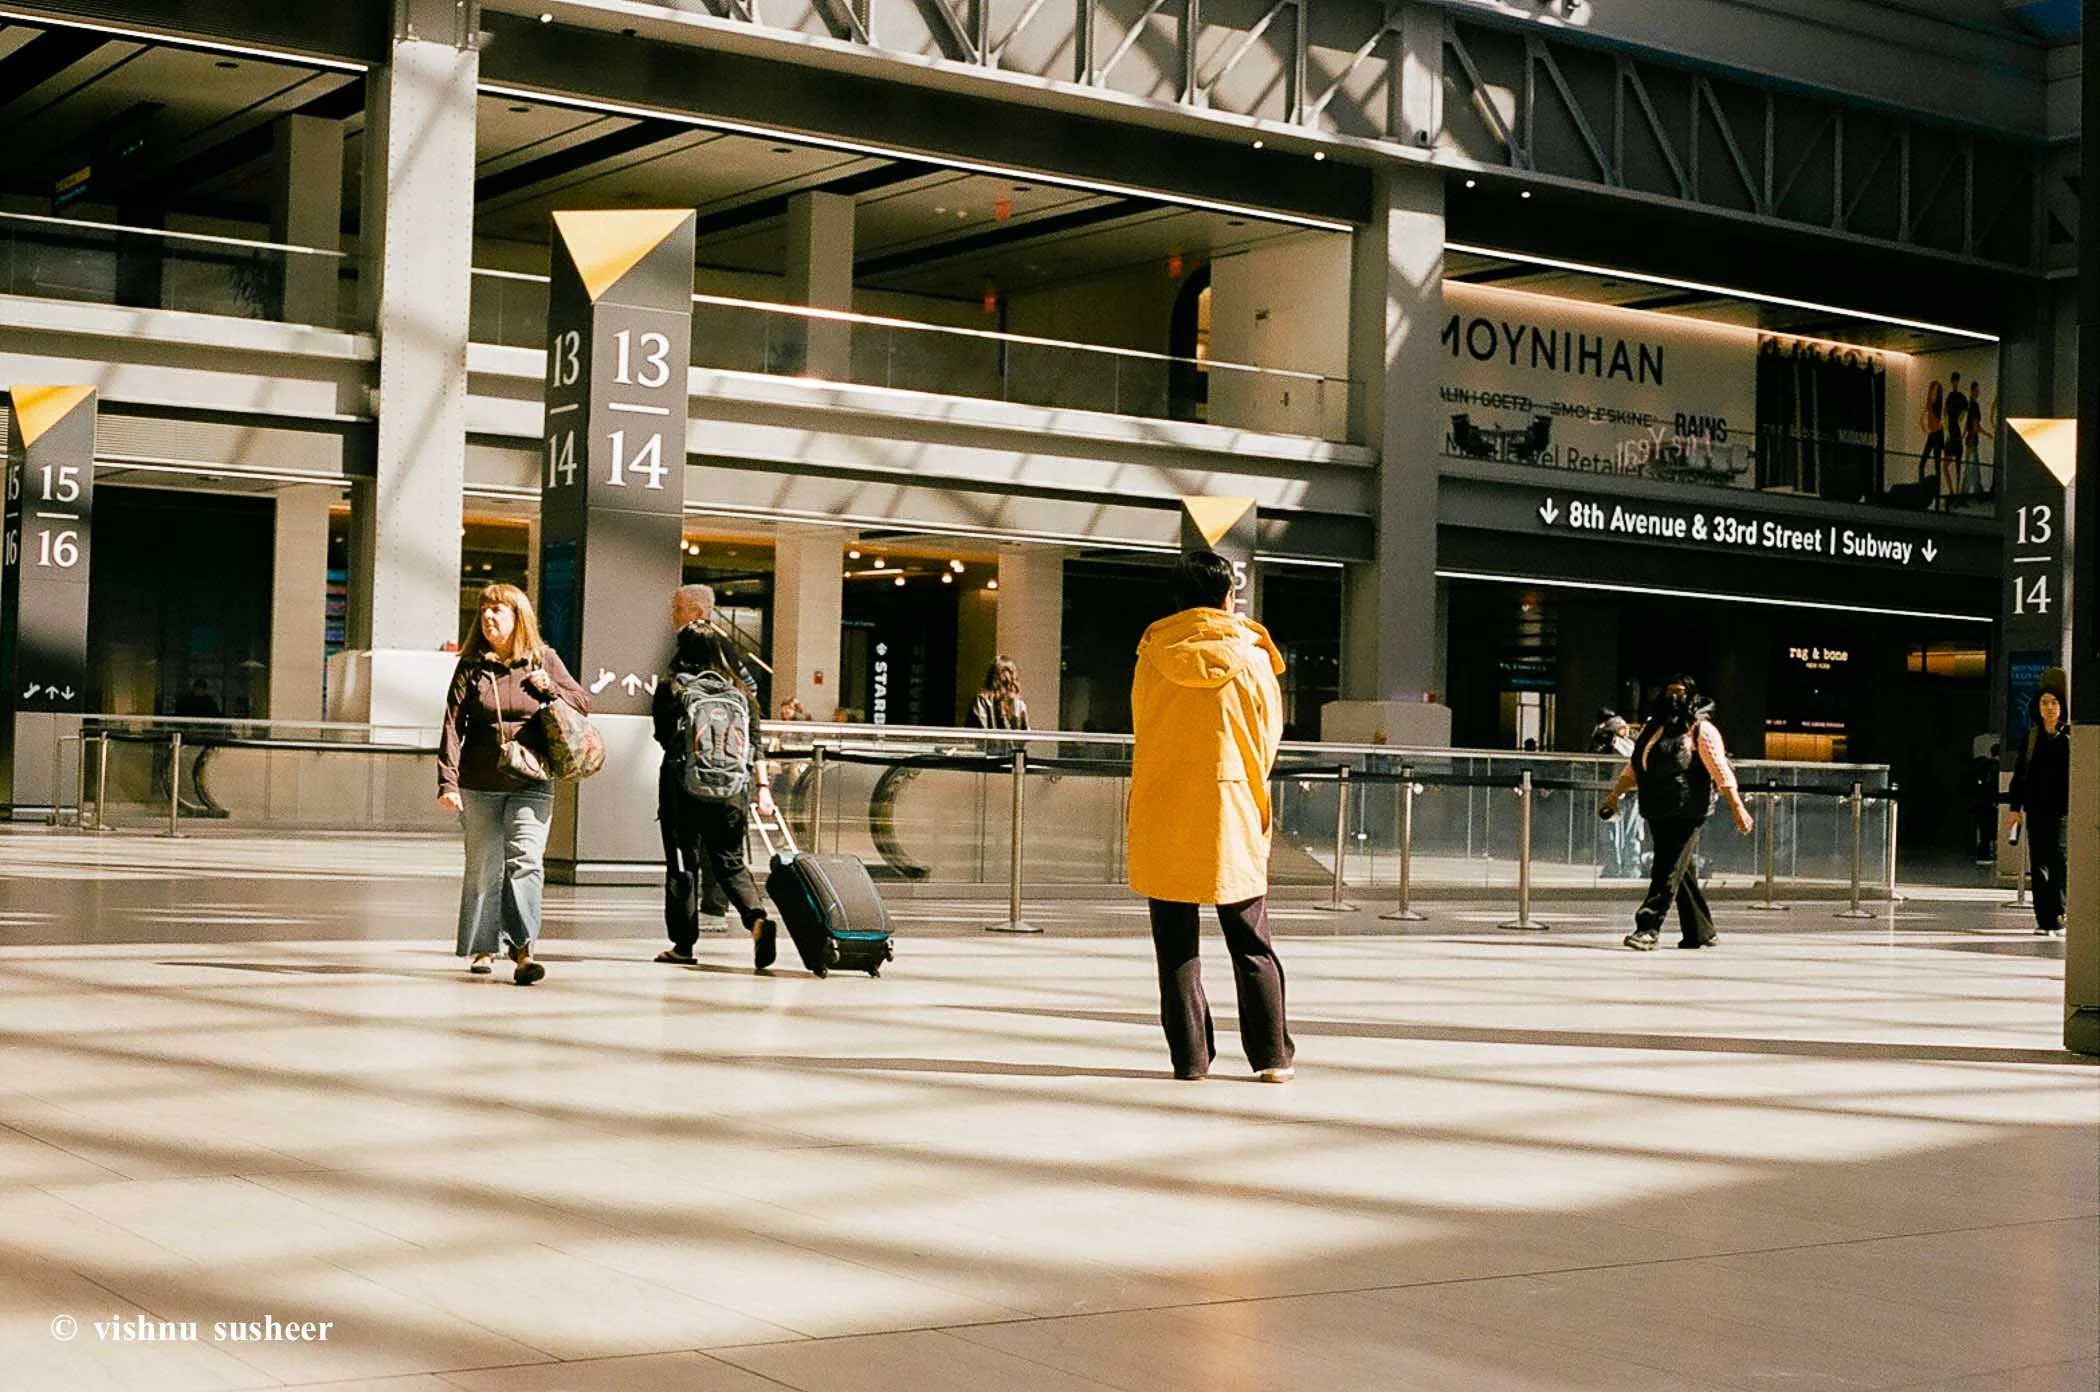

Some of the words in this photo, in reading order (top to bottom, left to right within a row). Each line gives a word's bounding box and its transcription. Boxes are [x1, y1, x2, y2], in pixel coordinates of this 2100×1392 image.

[553, 330, 580, 388] 13
[612, 329, 671, 389] 13
[1674, 412, 1728, 443] RAINS
[548, 429, 577, 489] 14
[605, 429, 669, 490] 14
[8, 465, 20, 501] 15
[40, 464, 80, 502] 15
[1569, 500, 1605, 530] 8th
[1610, 505, 1686, 538] Avenue
[1691, 513, 1708, 540] &
[1713, 515, 1758, 545] 33rd
[1762, 521, 1822, 552] Street
[1842, 530, 1913, 565] Subway
[2015, 505, 2052, 544] 13
[5, 529, 18, 566] 16
[37, 530, 79, 568] 16
[1232, 561, 1248, 590] 5
[2013, 575, 2052, 615] 14
[873, 661, 888, 725] STARB
